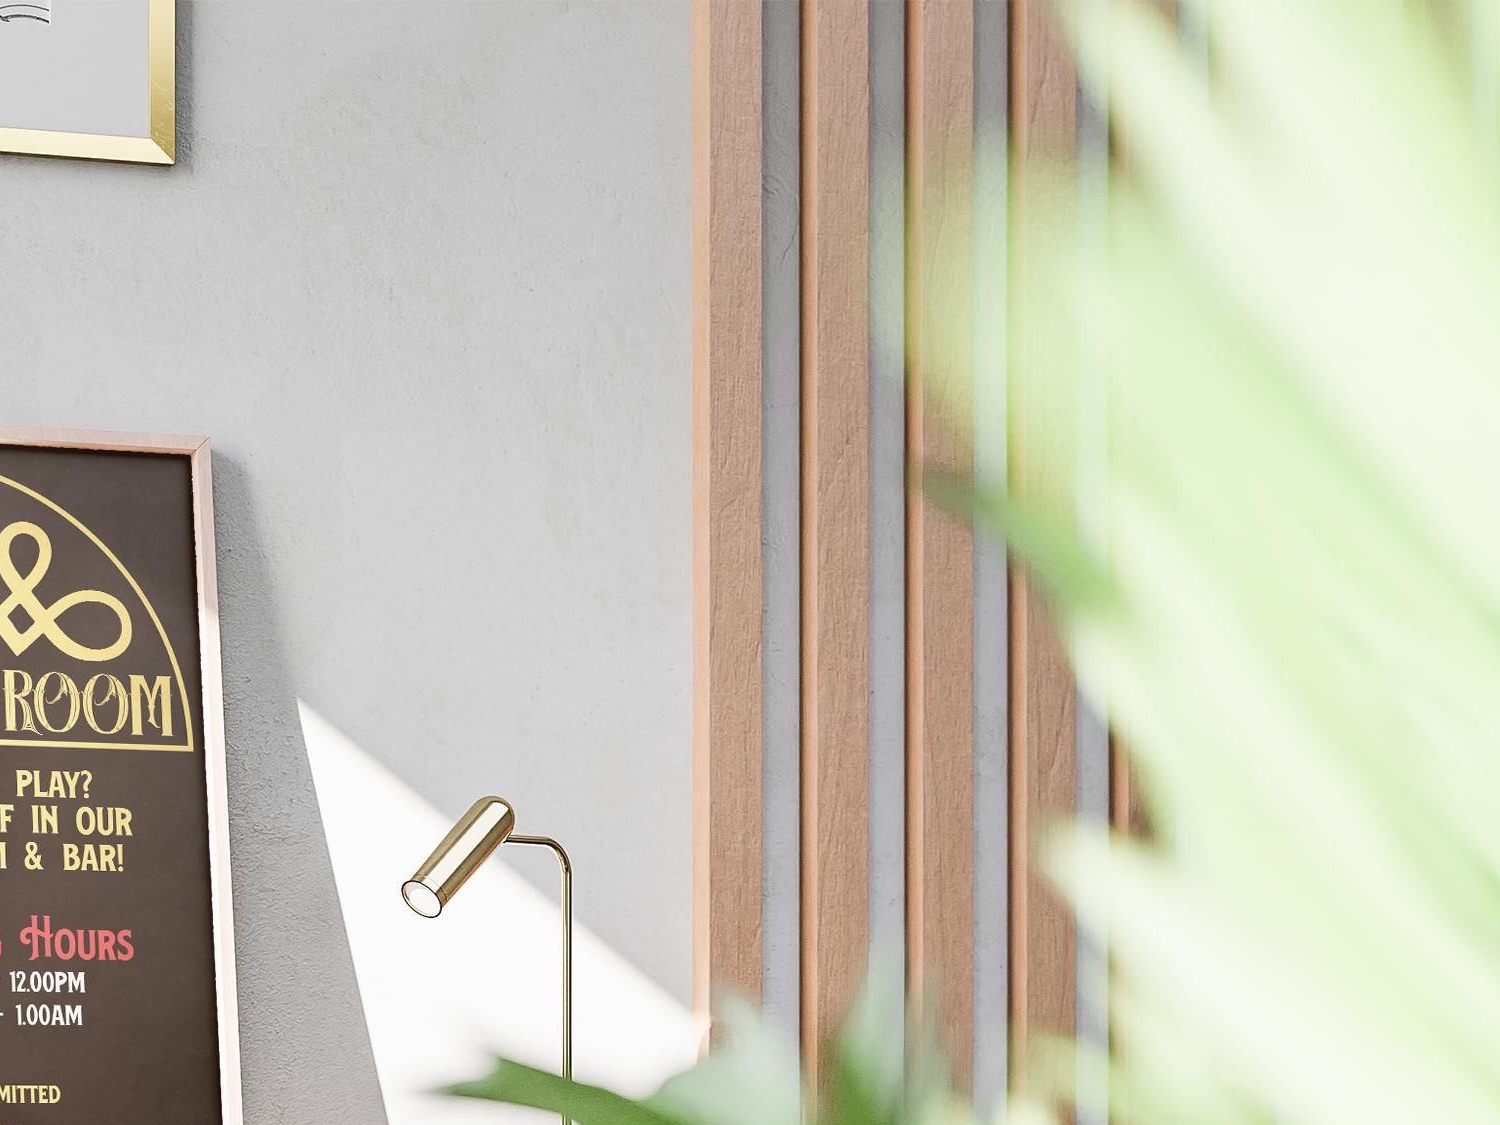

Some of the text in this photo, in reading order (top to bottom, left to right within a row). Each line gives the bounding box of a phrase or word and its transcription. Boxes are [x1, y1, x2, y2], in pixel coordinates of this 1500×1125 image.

[1, 668, 174, 737] ROOM
[15, 769, 93, 799] PLAY?
[30, 804, 60, 835] IN
[75, 806, 133, 837] OUR
[23, 841, 45, 871] &
[62, 843, 124, 873] BAR!
[9, 970, 86, 994] 12.00PM
[15, 1003, 83, 1026] 1.00AM
